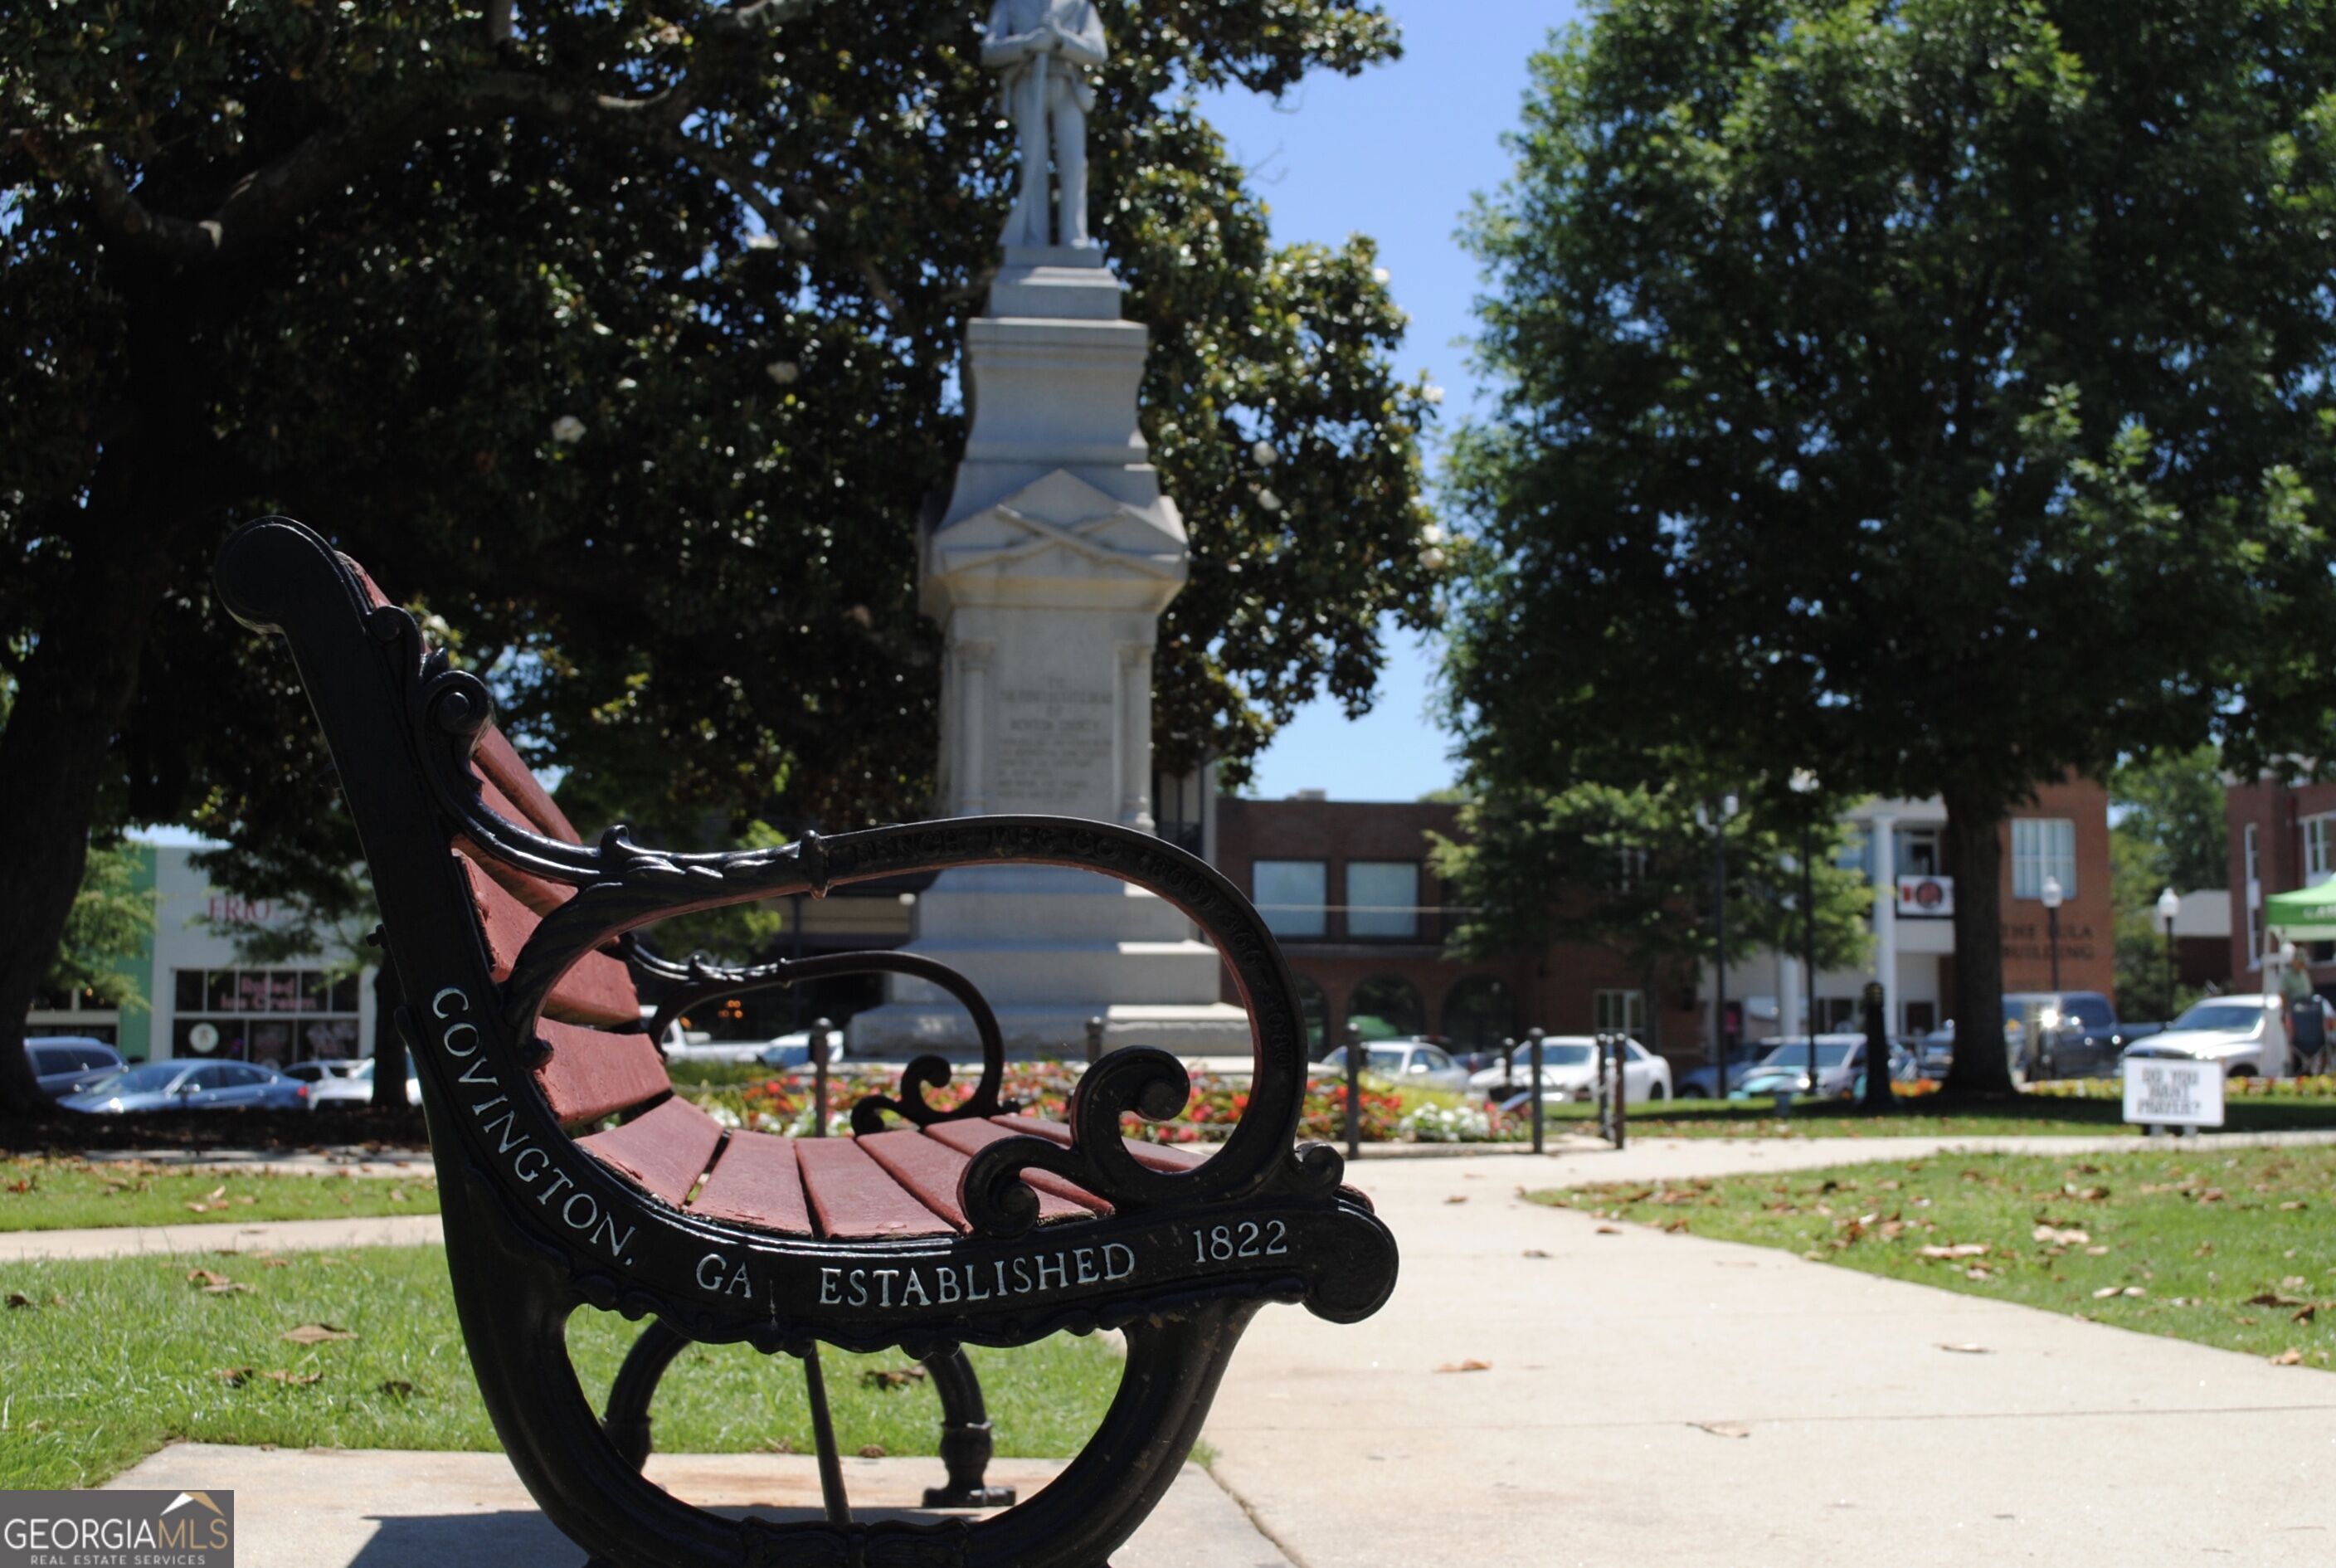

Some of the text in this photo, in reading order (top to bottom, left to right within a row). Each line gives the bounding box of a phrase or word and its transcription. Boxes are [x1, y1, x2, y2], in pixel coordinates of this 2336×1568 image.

[1073, 830, 1122, 860] CO
[208, 895, 270, 921] FRIO
[696, 1253, 753, 1299] GA
[820, 1242, 1136, 1307] ESTABLISHED
[1193, 1220, 1289, 1264] 1822
